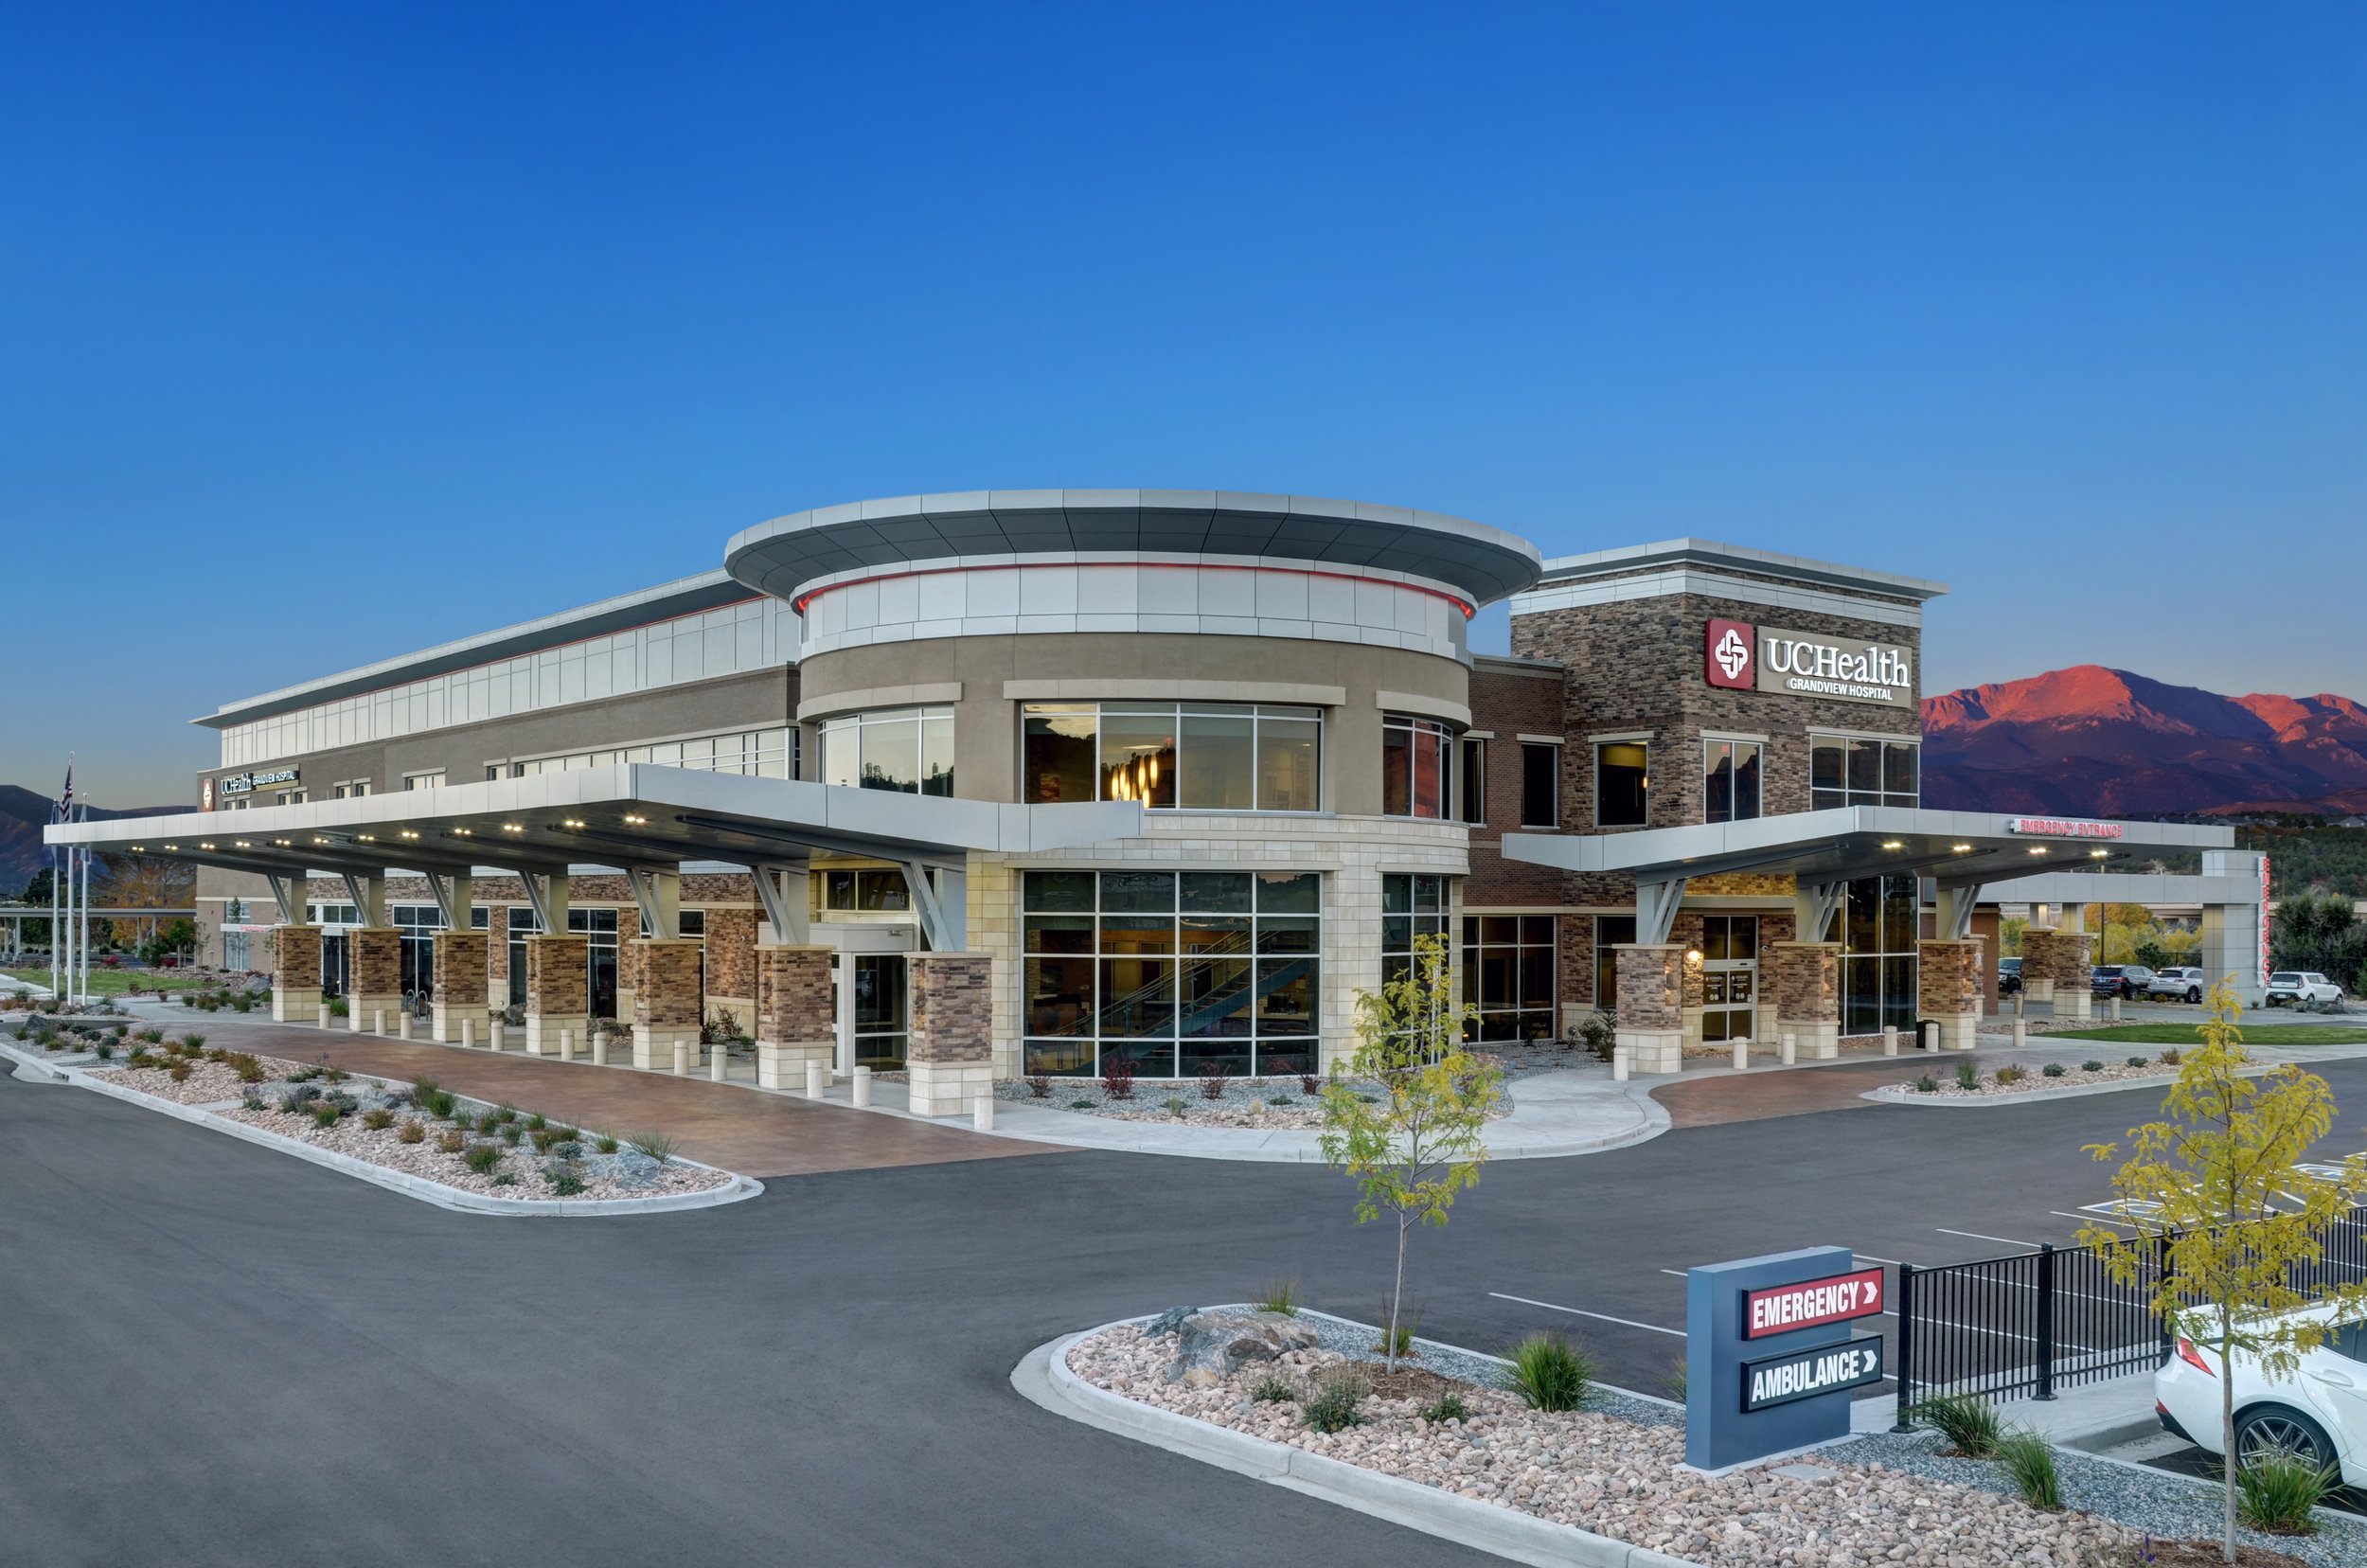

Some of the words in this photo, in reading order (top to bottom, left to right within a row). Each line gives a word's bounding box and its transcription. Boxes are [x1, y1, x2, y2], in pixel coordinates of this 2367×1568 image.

[1765, 637, 1911, 687] UCHealth
[1789, 677, 1847, 697] GRANDVIEW
[1849, 684, 1893, 701] HOSPITAL
[221, 772, 252, 794] UCHealth
[2020, 819, 2075, 834] EMERGENCY
[2078, 823, 2122, 837] ENTRANCE
[2261, 857, 2270, 987] EMERGENCY
[1753, 1280, 1860, 1329] EMERGENCY
[1752, 1349, 1860, 1402] AMBULANCE
